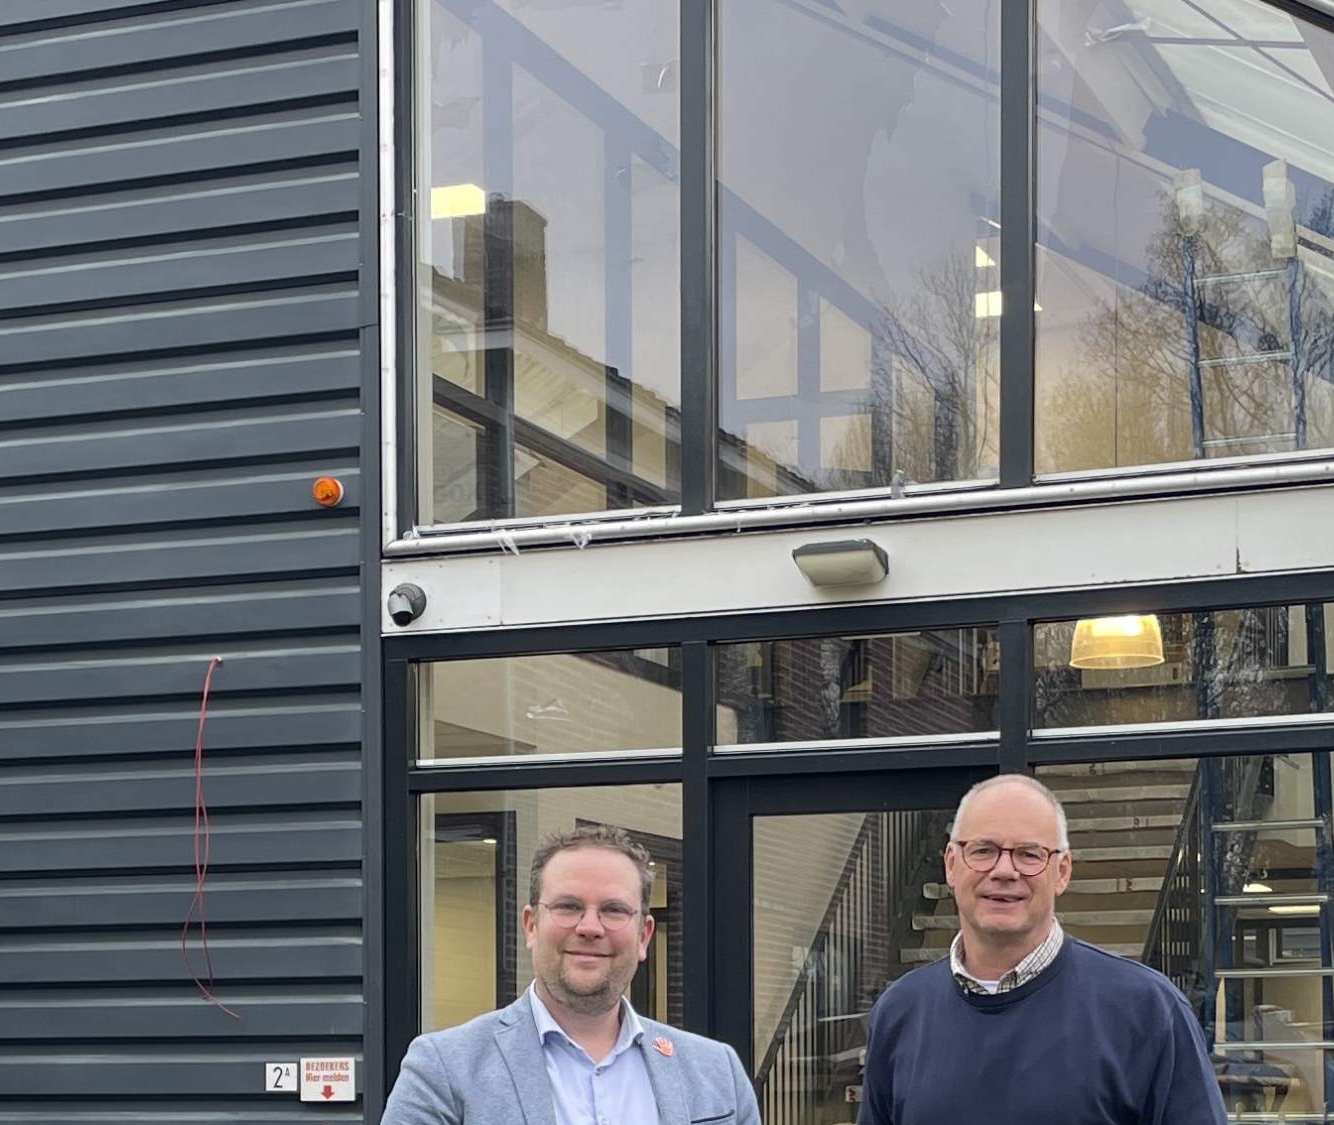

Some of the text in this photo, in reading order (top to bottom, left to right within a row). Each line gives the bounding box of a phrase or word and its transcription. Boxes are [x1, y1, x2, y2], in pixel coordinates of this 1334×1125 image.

[305, 1061, 350, 1071] BEZOEKERS
[305, 1073, 350, 1082] Hier melden
